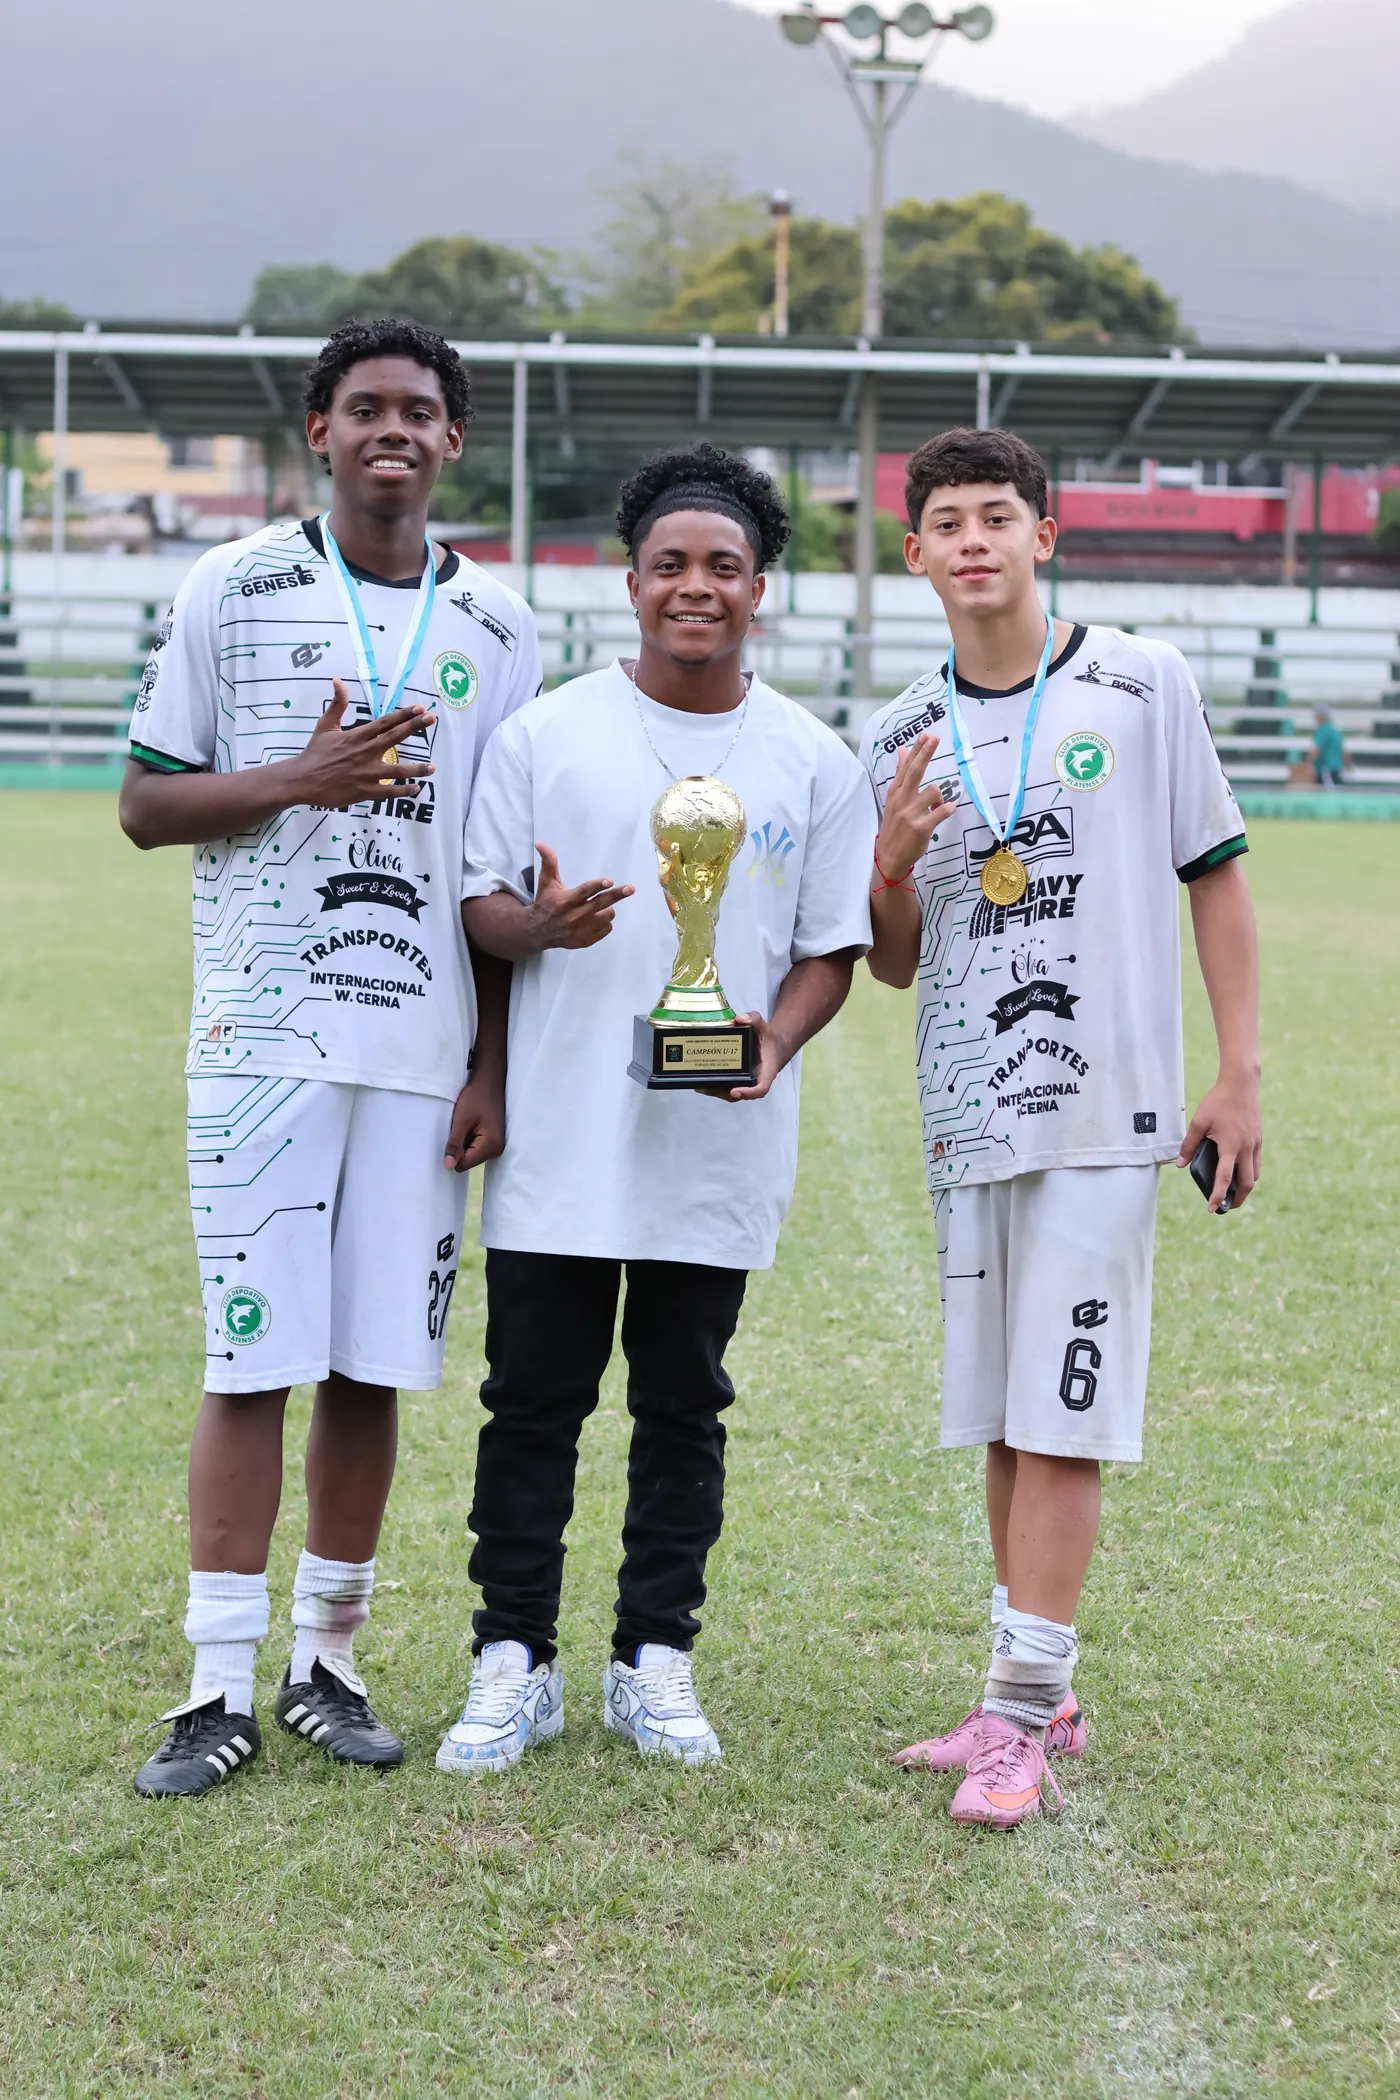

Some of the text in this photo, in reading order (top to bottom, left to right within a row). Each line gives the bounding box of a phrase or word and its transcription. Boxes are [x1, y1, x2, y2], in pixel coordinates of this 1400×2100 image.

[241, 564, 316, 597] GENESIS
[481, 618, 509, 643] BAIDE
[437, 654, 476, 681] CLUB DEPORTIVO
[438, 687, 461, 707] PLATENSE
[1111, 679, 1144, 698] BAIDE
[883, 701, 946, 754] GENESIS
[1058, 734, 1108, 758] CLUB DEPORTIVO
[1066, 772, 1107, 788] PLATENSE JR
[348, 838, 404, 873] Oliva
[336, 881, 413, 906] Sweet & Lovely
[1007, 873, 1085, 908] EAVY
[300, 929, 433, 982] TRANSPORTES
[310, 972, 426, 997] INTERNACIONAL
[334, 989, 401, 1009] W. CERNA
[1031, 988, 1060, 1007] Lovely
[686, 1046, 739, 1056] CAMPEÓN U-17
[1020, 1099, 1060, 1116] CERNA
[222, 1288, 266, 1309] CLUB DEPORTIVO
[427, 1269, 457, 1341] 27
[225, 1328, 265, 1343] PLATENSE JR
[1059, 1338, 1102, 1412] 6
